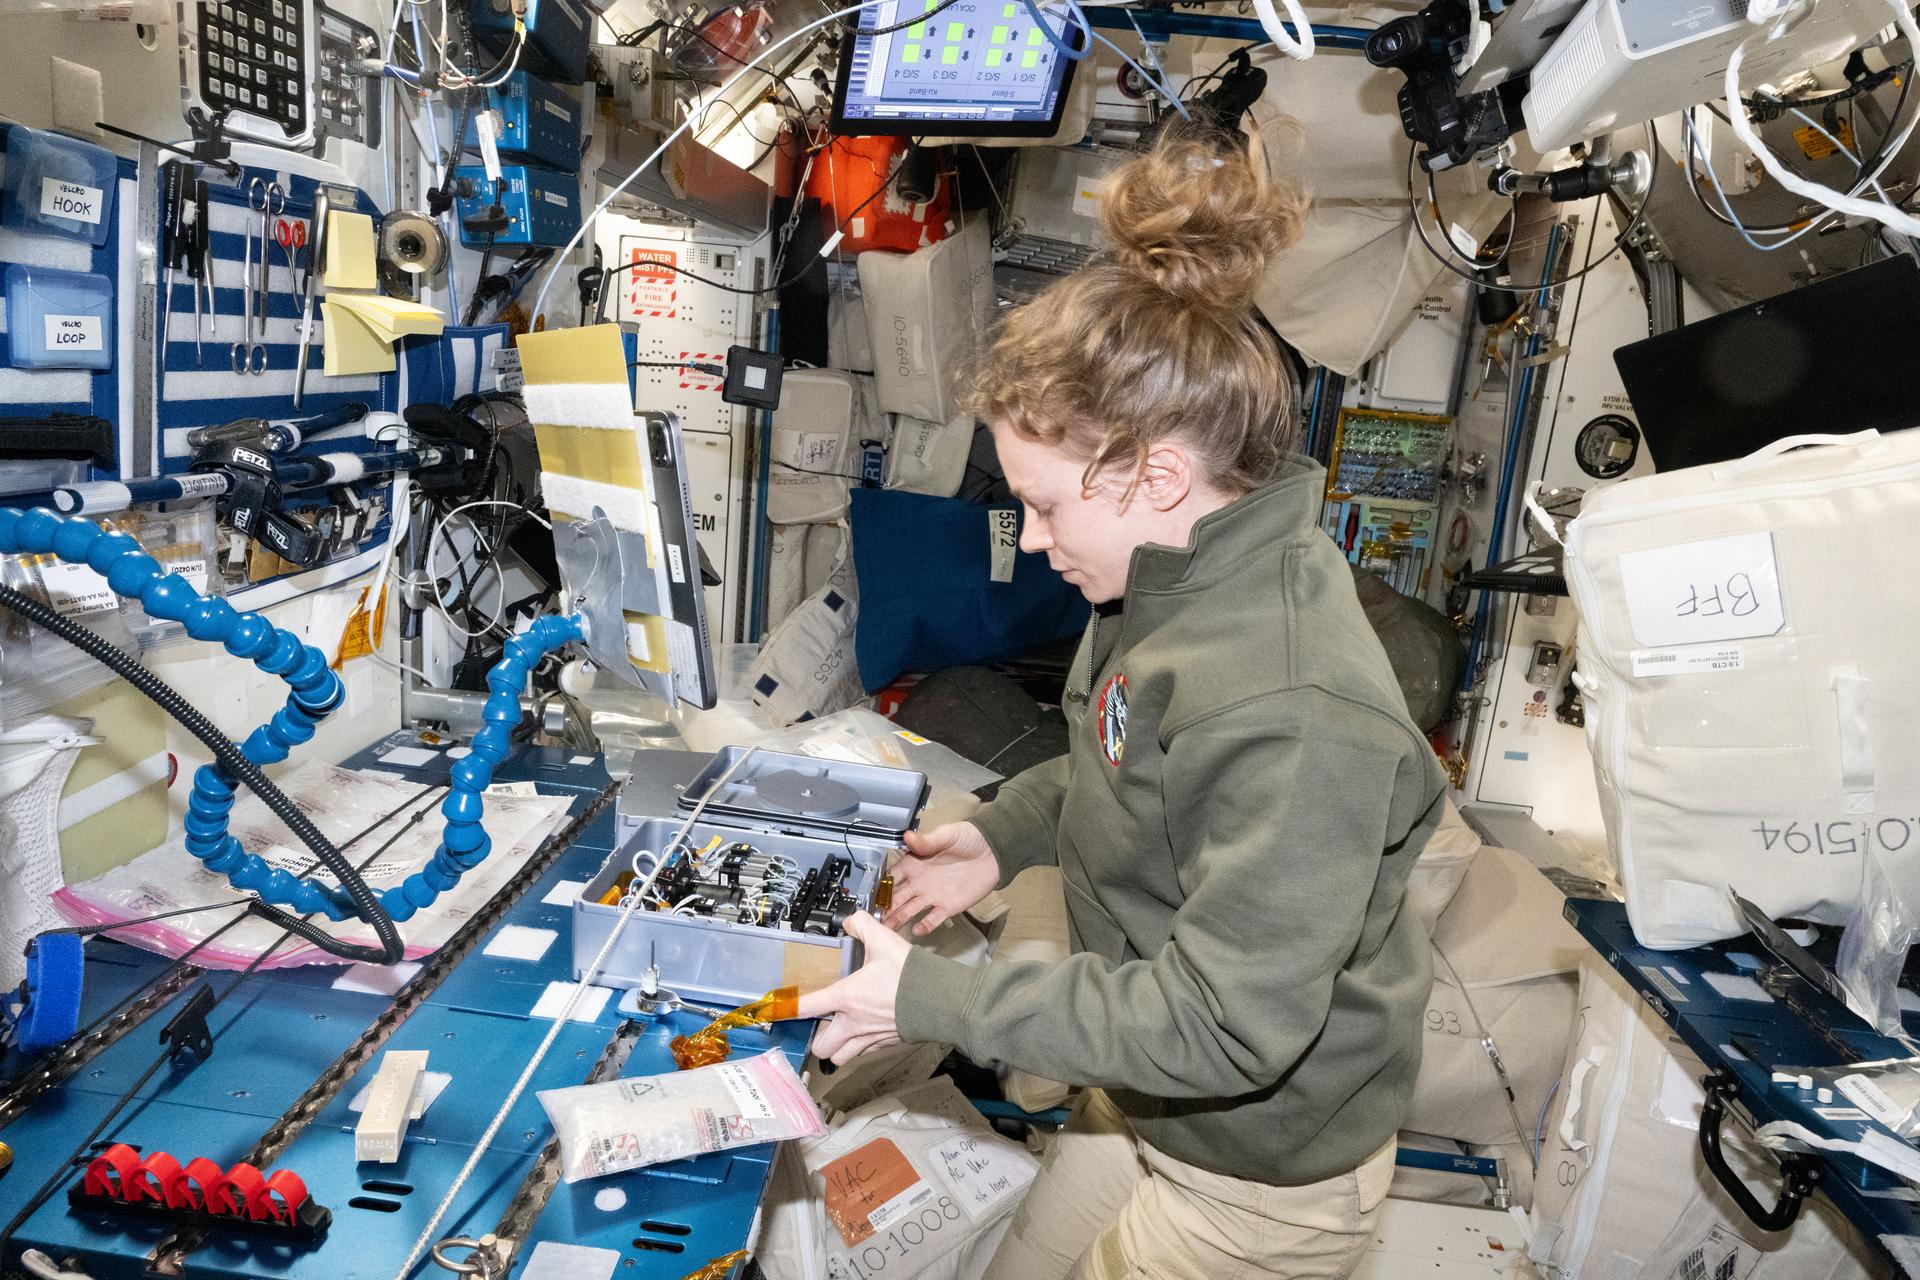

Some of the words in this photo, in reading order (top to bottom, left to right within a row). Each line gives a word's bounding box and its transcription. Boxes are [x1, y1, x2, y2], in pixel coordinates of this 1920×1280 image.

[894, 69, 899, 78] 4
[902, 69, 920, 79] S/G
[932, 70, 938, 79] 3
[941, 70, 958, 80] S/G
[977, 71, 982, 80] 2
[985, 71, 1002, 81] S/G
[1020, 73, 1036, 82] S/G
[909, 87, 938, 96] Ku-Band
[992, 90, 1015, 98] S-Band
[59, 184, 85, 196] VELCRO
[53, 196, 93, 216] HOOK
[638, 252, 672, 263] WATER
[633, 263, 655, 272] MIST
[644, 293, 663, 302] FIRE
[1424, 304, 1452, 312] Control
[1419, 312, 1439, 321] Panel
[60, 320, 82, 328] VELCRO
[56, 332, 86, 344] LOOP
[232, 447, 272, 472] PETZL
[998, 511, 1016, 548] 5572
[266, 520, 289, 550] PETZL
[1676, 572, 1760, 617] BFF
[84, 603, 104, 612] Battery
[104, 600, 114, 608] AA
[813, 648, 843, 685] 4265
[1712, 661, 1728, 669] CTB
[959, 1137, 978, 1153] Ops
[830, 1161, 878, 1198] VAC
[947, 1166, 965, 1184] AC
[849, 1195, 961, 1280] 1.0-1008
